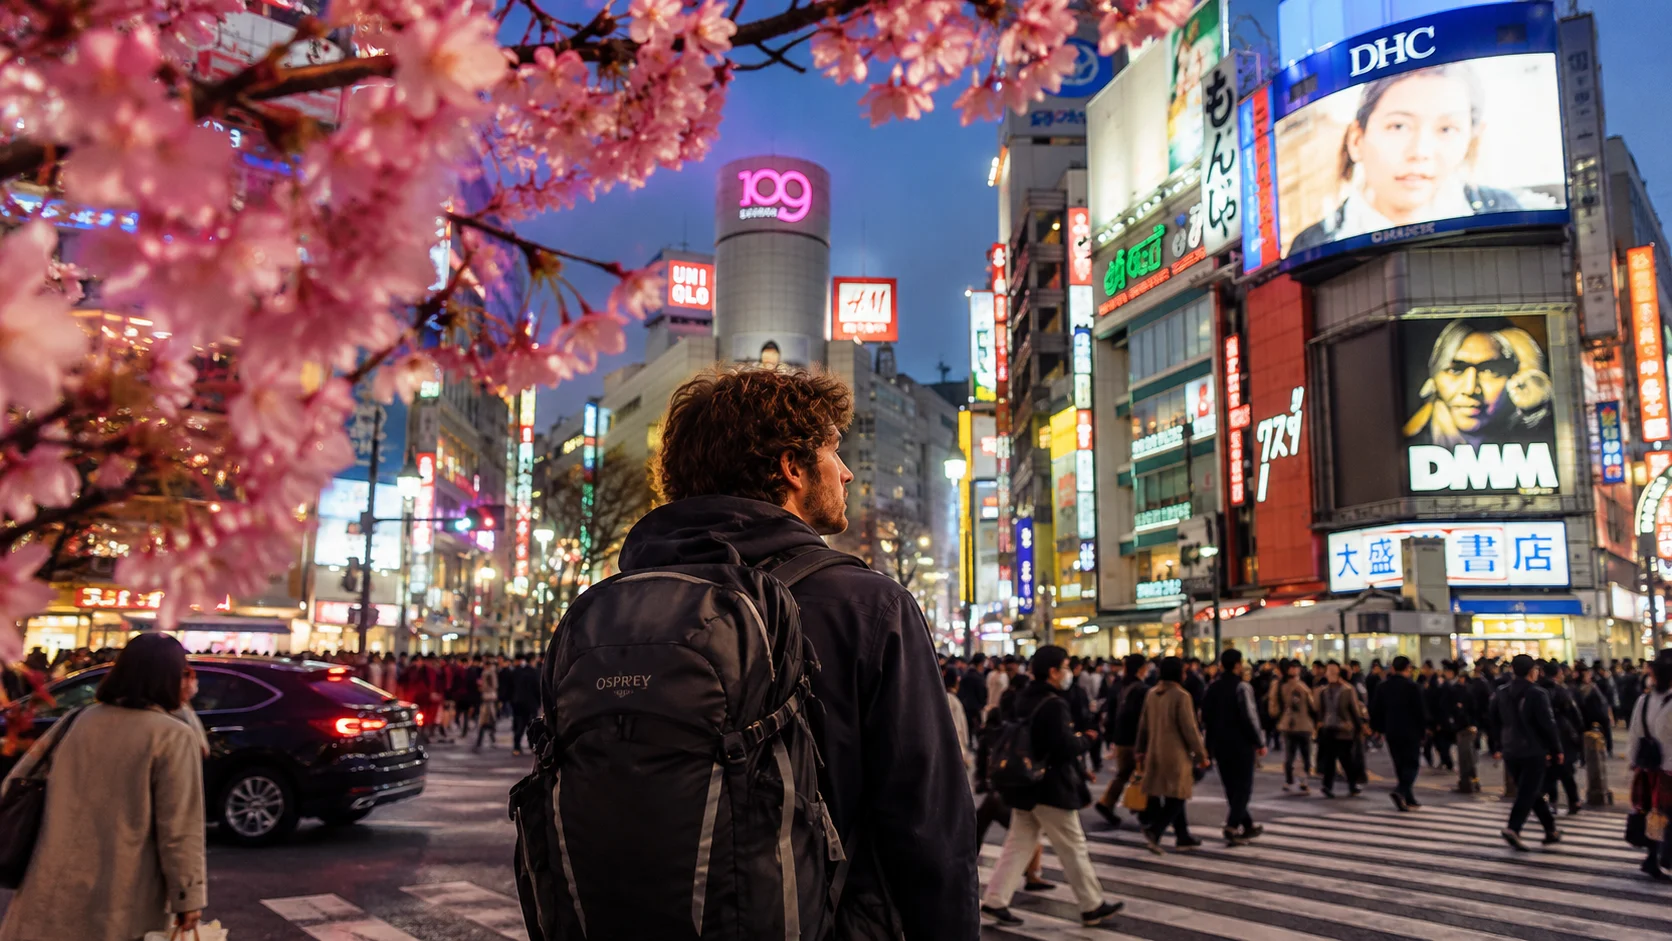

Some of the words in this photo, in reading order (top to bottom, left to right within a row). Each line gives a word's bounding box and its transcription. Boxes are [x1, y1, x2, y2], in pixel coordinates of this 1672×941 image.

[1349, 25, 1436, 78] DHC
[1206, 70, 1237, 239] もんじゃ
[738, 168, 813, 223] 109
[671, 285, 710, 306] QLO
[672, 265, 707, 287] UNI
[1409, 442, 1559, 491] DMM
[1336, 533, 1553, 578] 大盛書店
